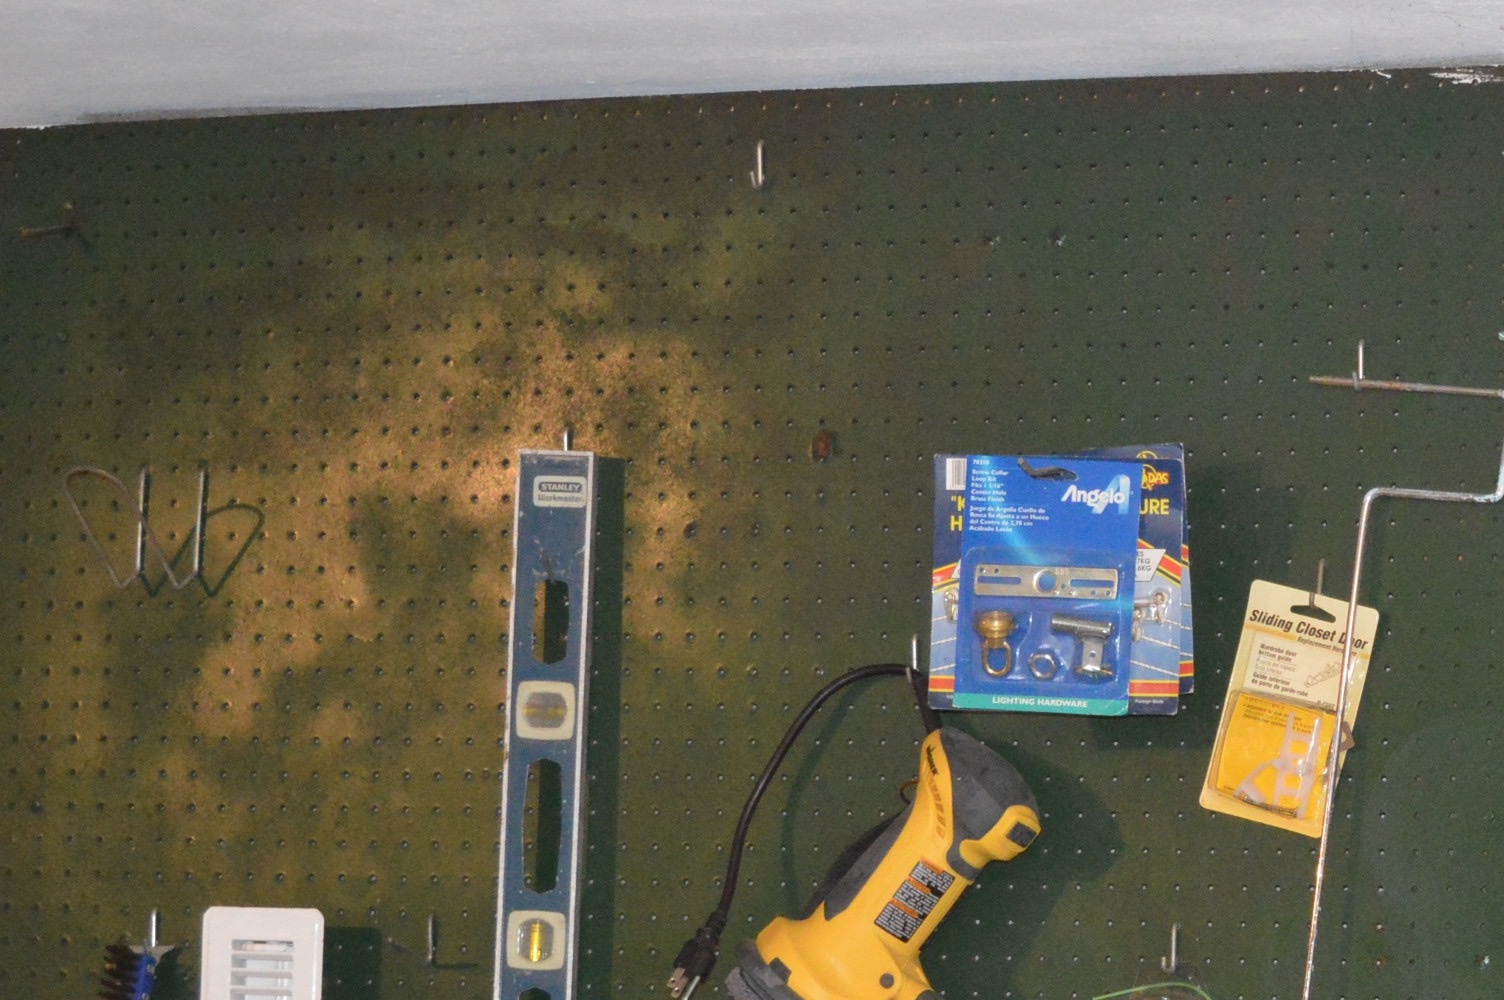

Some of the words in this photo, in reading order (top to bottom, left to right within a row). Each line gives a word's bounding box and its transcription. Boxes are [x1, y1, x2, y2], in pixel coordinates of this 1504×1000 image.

[541, 483, 580, 491] STANLEY
[1061, 484, 1126, 507] Angelo
[1249, 609, 1293, 633] Sliding
[1296, 621, 1336, 640] Closet
[1260, 643, 1284, 654] Wardrobe
[1297, 636, 1331, 649] Replacement
[992, 696, 1035, 706] LIGHTING
[1037, 697, 1088, 708] HARDWARE
